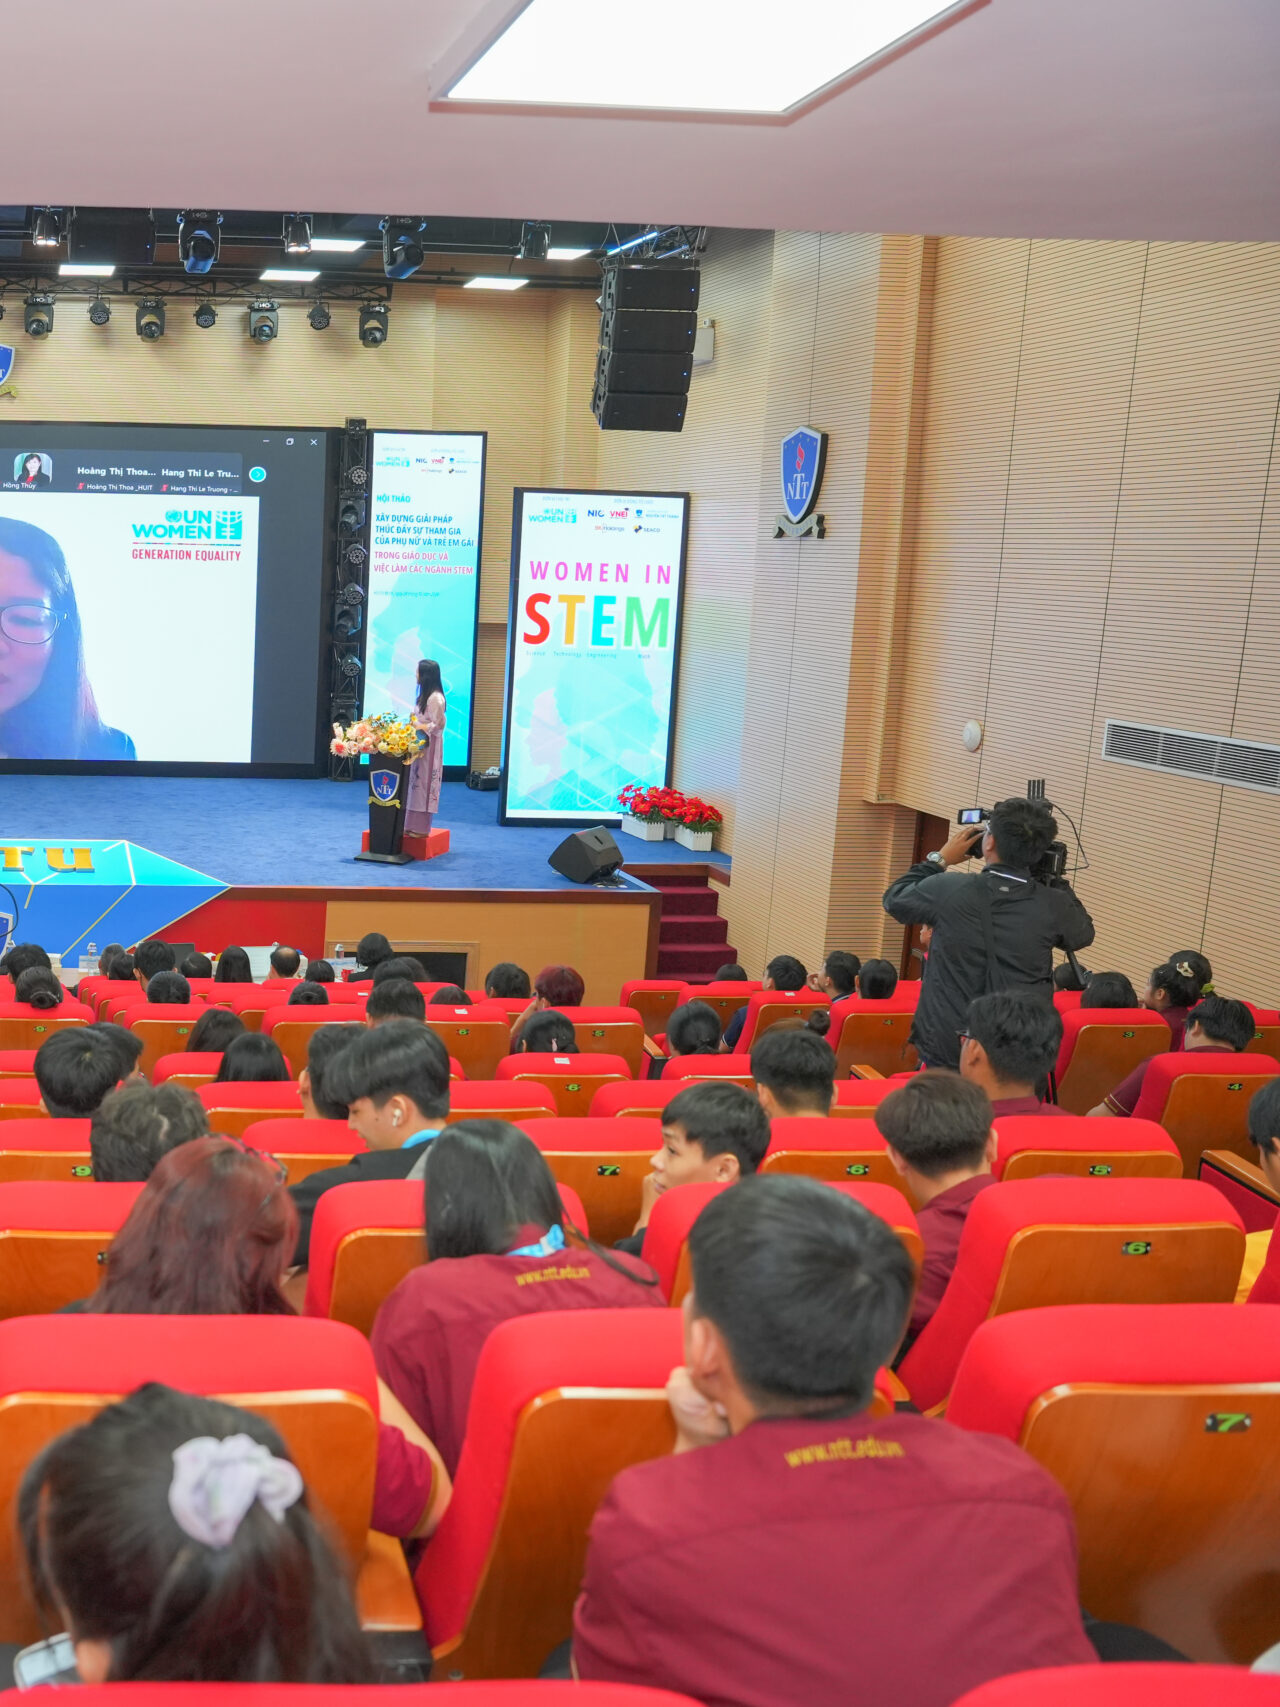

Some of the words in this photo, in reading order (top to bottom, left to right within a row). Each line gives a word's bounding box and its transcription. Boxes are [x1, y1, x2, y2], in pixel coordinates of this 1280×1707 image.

[77, 467, 106, 476] Hoàng
[109, 467, 124, 477] Thị
[162, 468, 185, 478] Hang
[188, 469, 202, 477] Thi
[204, 469, 215, 478] Le
[3, 481, 19, 490] Hồng
[86, 483, 107, 492] Hoàng
[170, 485, 187, 493] Hang
[786, 473, 809, 500] NTT
[377, 493, 390, 503] HỘI
[392, 493, 411, 503] THẢO
[183, 510, 212, 524] UN
[376, 512, 390, 522] XÂY
[391, 514, 414, 524] DỰNG
[416, 513, 432, 523] GIẢI
[433, 513, 453, 523] PHÁP
[528, 515, 564, 523] WOMEN
[587, 509, 605, 518] NIC
[131, 523, 212, 539] WOMEN
[375, 524, 395, 534] THÚC
[425, 527, 447, 535] THAM
[448, 527, 461, 535] GIA
[375, 535, 390, 545] CỦA
[391, 537, 407, 547] PHỤ
[422, 536, 432, 546] VÀ
[448, 538, 460, 547] EM
[461, 537, 474, 547] GÁI
[132, 548, 192, 560] GENERATION
[195, 550, 241, 561] EQUALITY
[374, 551, 400, 560] TRONG
[401, 549, 421, 560] GIÁO
[422, 552, 437, 563] DỤC
[438, 550, 449, 561] VÀ
[391, 563, 408, 573] LÀM
[409, 563, 423, 573] CÁC
[424, 564, 452, 574] NGÀNH
[453, 566, 474, 575] STEM
[529, 561, 629, 583] WOMEN
[645, 564, 671, 585] IN
[523, 592, 670, 648] STEM
[376, 785, 393, 795] NTT
[75, 1166, 92, 1177] 9
[602, 1165, 618, 1176] 7
[849, 1165, 865, 1175] 6
[1094, 1165, 1109, 1175] 5
[1127, 1241, 1147, 1255] 6
[1216, 1413, 1247, 1432] 7
